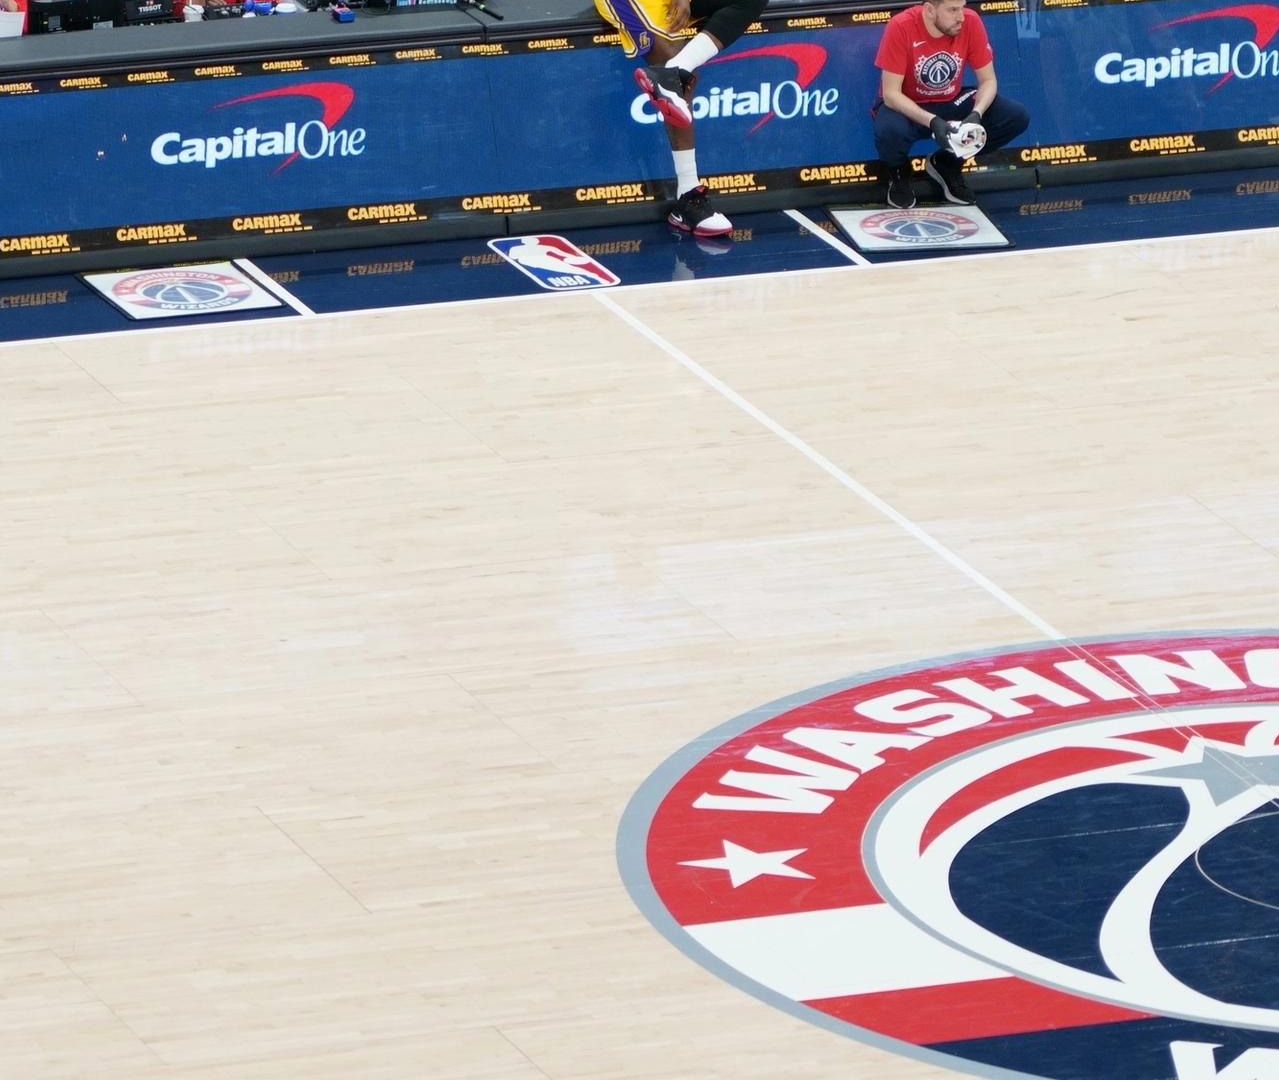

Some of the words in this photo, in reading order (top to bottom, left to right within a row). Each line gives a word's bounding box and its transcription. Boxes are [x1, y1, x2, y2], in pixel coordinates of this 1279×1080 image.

[138, 4, 162, 13] TISSOT
[867, 209, 955, 224] WASHINGTON
[895, 233, 967, 244] WIZARDS
[119, 271, 220, 291] WASHINGTON
[547, 274, 591, 287] NBA
[161, 296, 240, 311] WIZARDS
